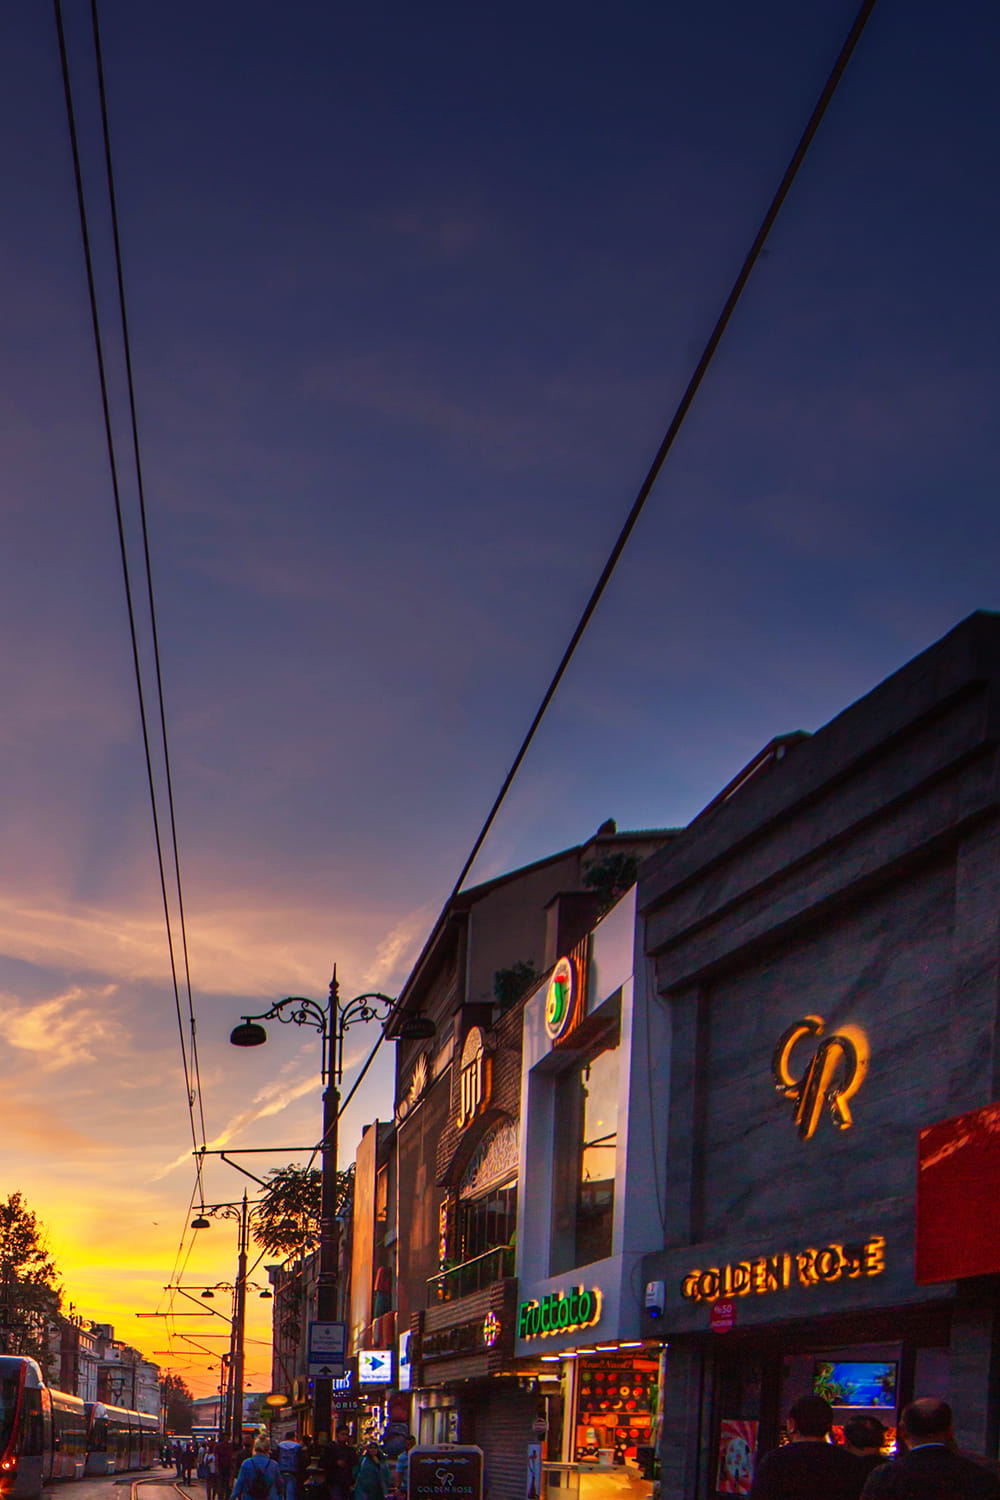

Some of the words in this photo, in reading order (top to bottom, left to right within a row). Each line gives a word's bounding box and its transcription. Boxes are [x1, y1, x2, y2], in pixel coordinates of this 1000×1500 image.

[681, 1254, 790, 1302] GOLDEN
[796, 1235, 886, 1287] ROSE
[517, 1284, 599, 1339] Fruttato
[416, 1486, 450, 1494] GOLDEN
